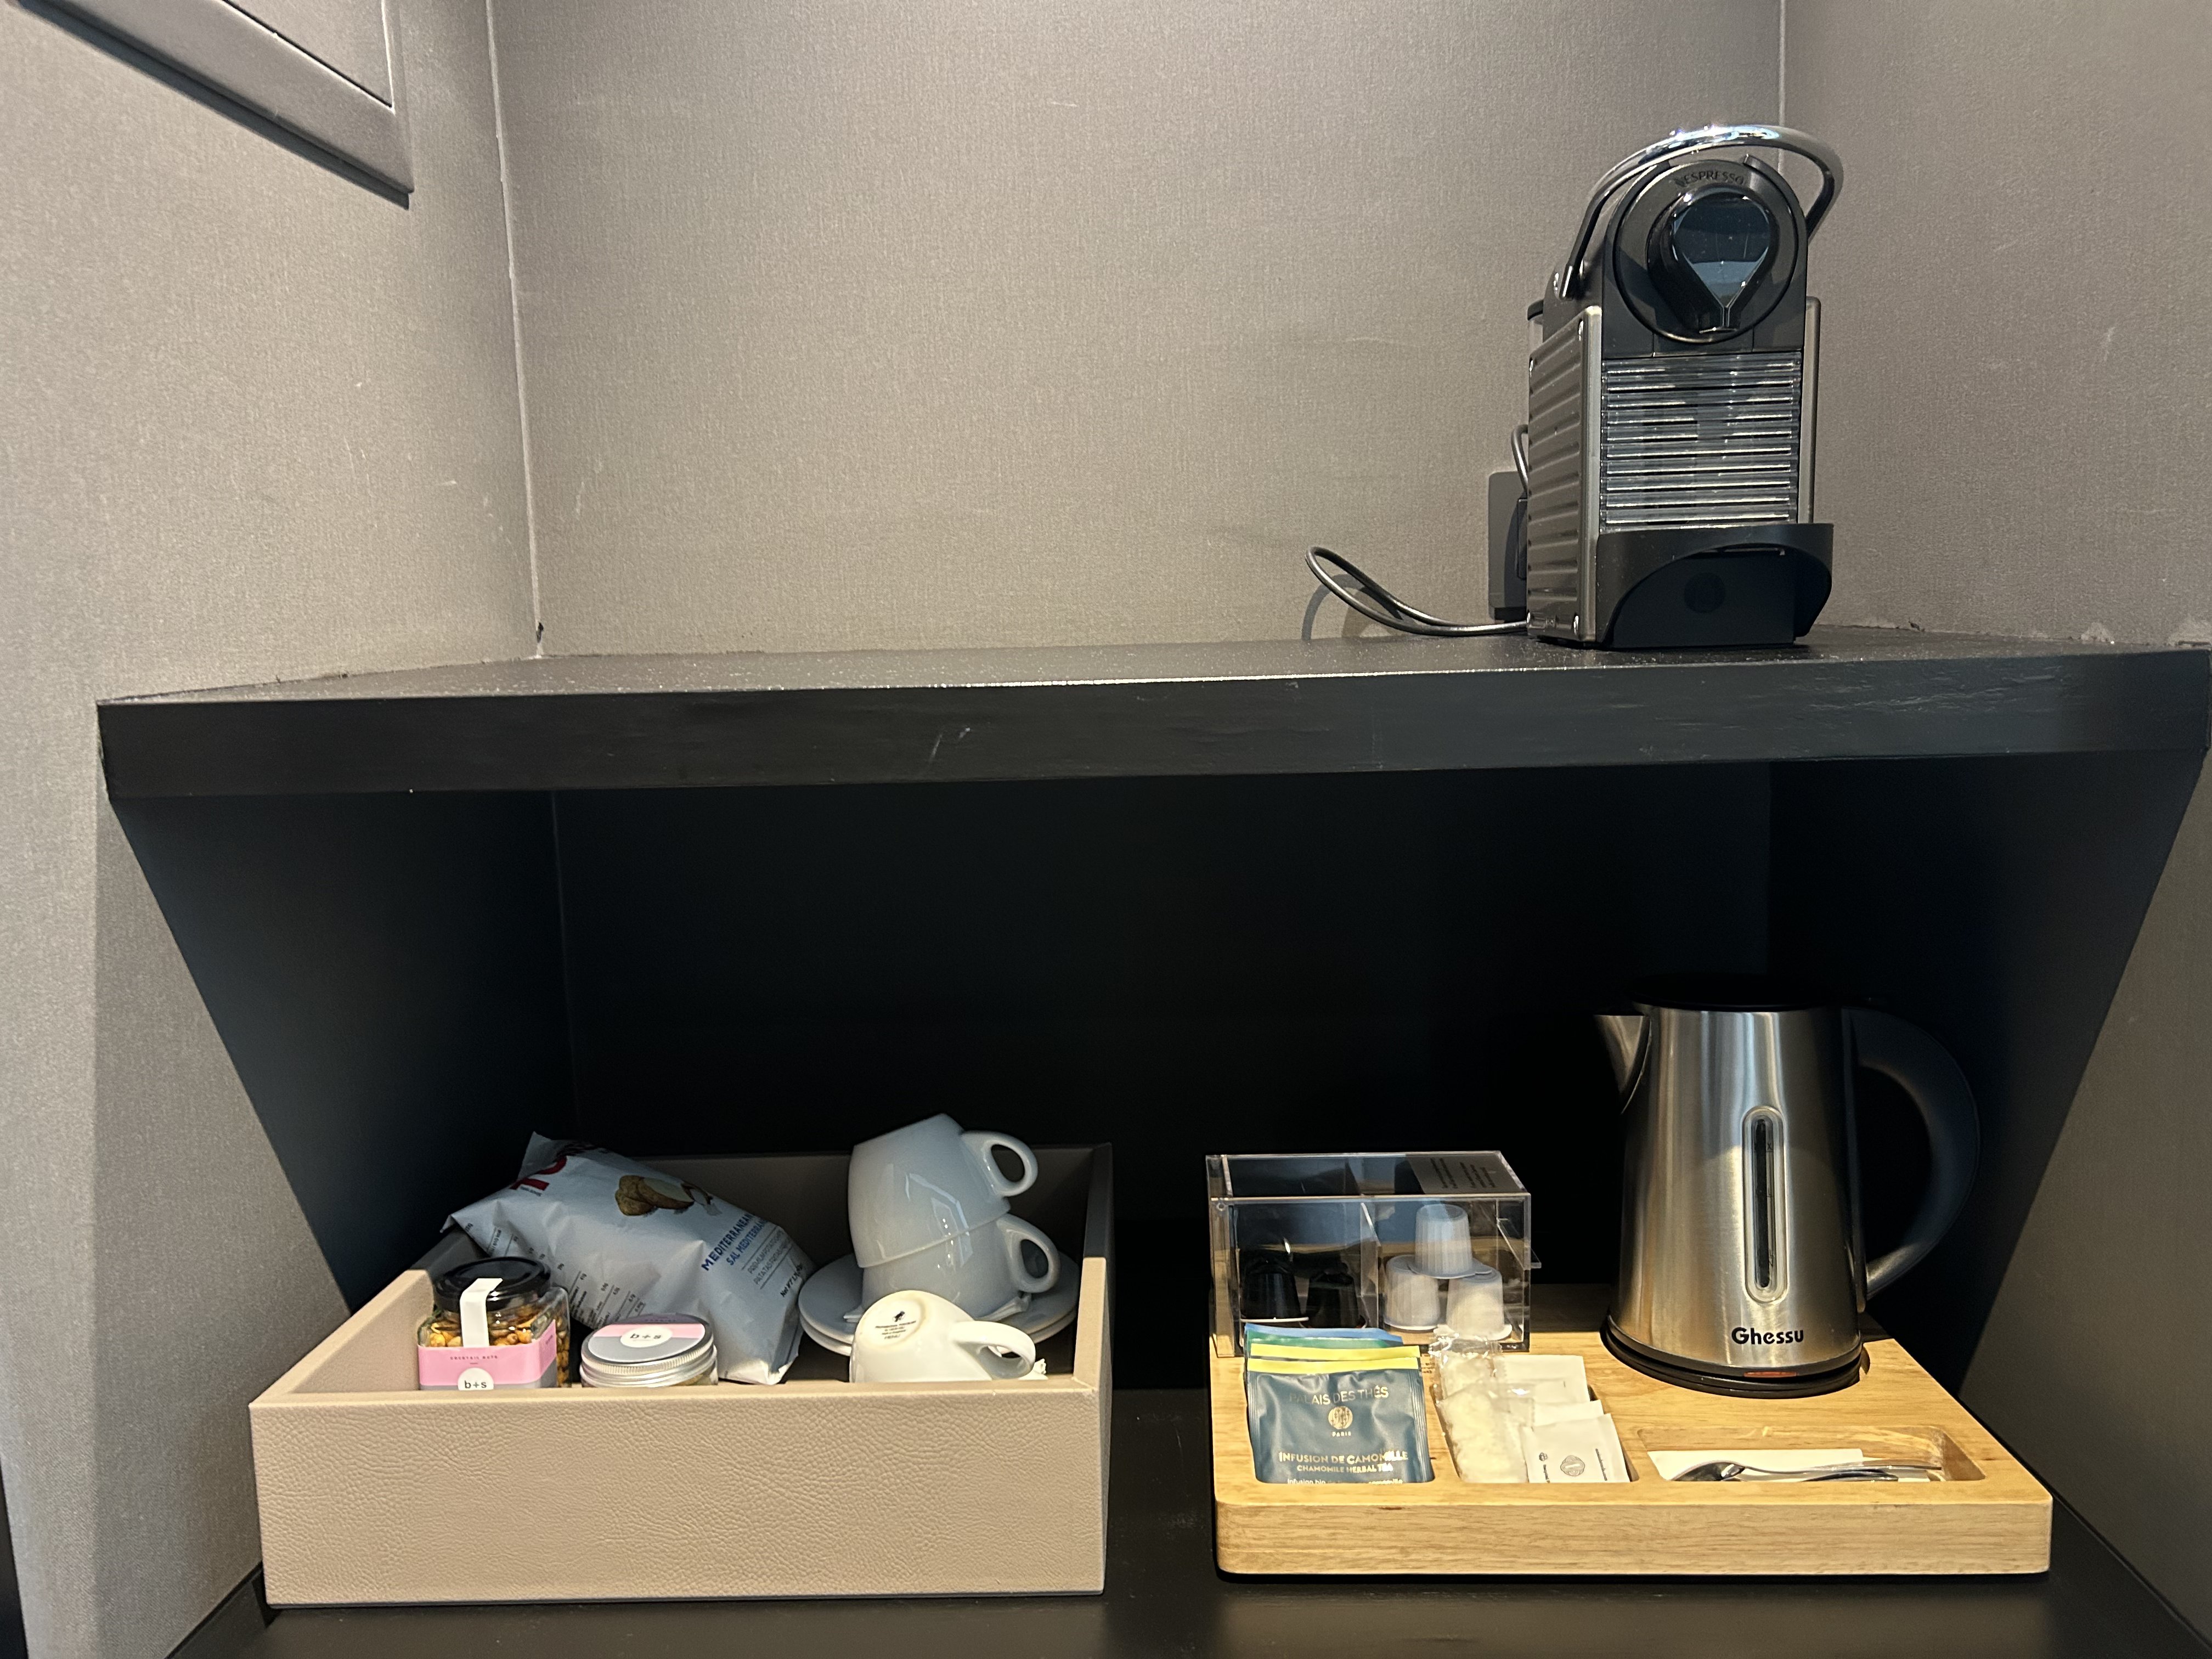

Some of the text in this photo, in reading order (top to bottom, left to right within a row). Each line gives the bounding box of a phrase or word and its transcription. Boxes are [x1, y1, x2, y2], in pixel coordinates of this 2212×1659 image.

[1674, 169, 1744, 187] NESPRESSO
[726, 1251, 741, 1266] SAL
[1731, 1327, 1804, 1345] Ghessu
[1290, 1394, 1331, 1405] PALAIS
[1333, 1391, 1356, 1403] DES
[1279, 1452, 1328, 1463] INFUSION
[1331, 1455, 1345, 1464] DE
[1346, 1464, 1376, 1474] HERBAL
